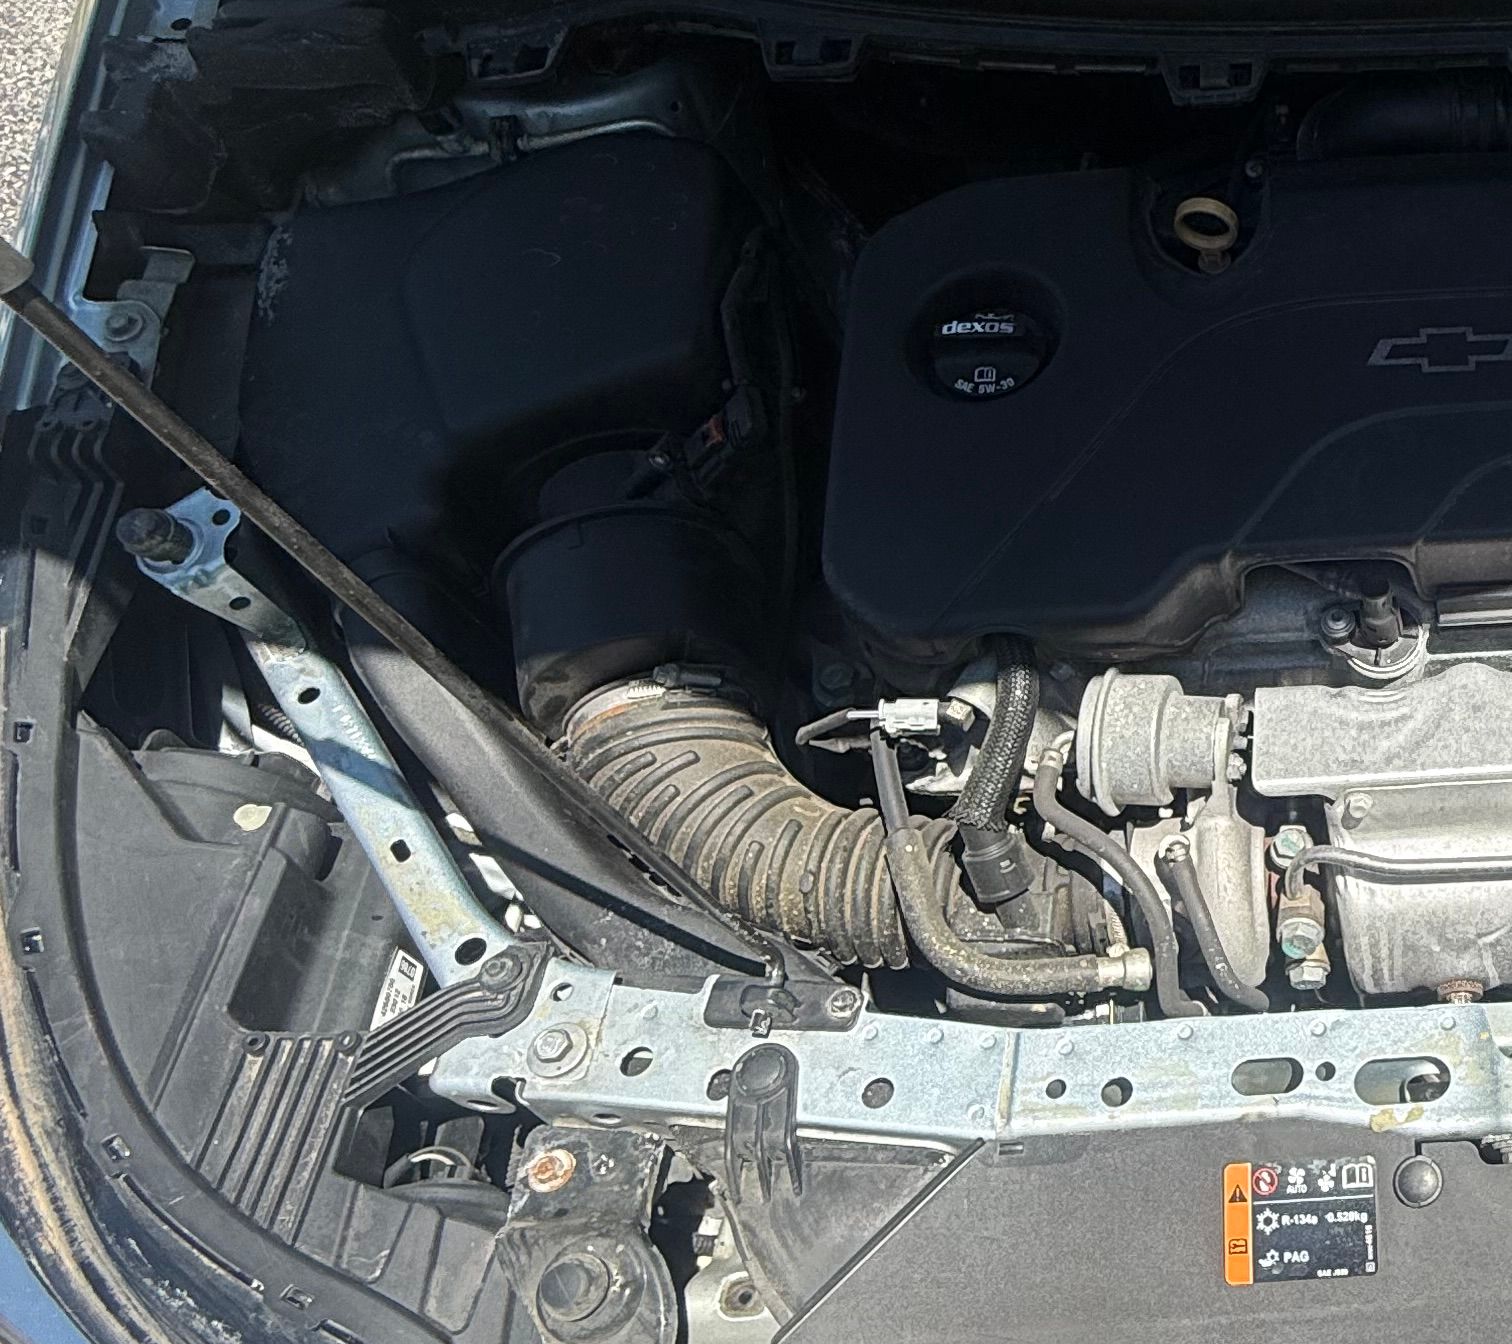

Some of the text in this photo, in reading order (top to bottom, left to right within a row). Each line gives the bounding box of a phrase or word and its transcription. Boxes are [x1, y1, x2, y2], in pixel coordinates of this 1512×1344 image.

[941, 320, 1015, 335] dexos
[954, 378, 974, 393] SAE
[1286, 1184, 1308, 1194] AUTO
[1281, 1213, 1319, 1226] R-134a
[1283, 1250, 1310, 1263] PAG
